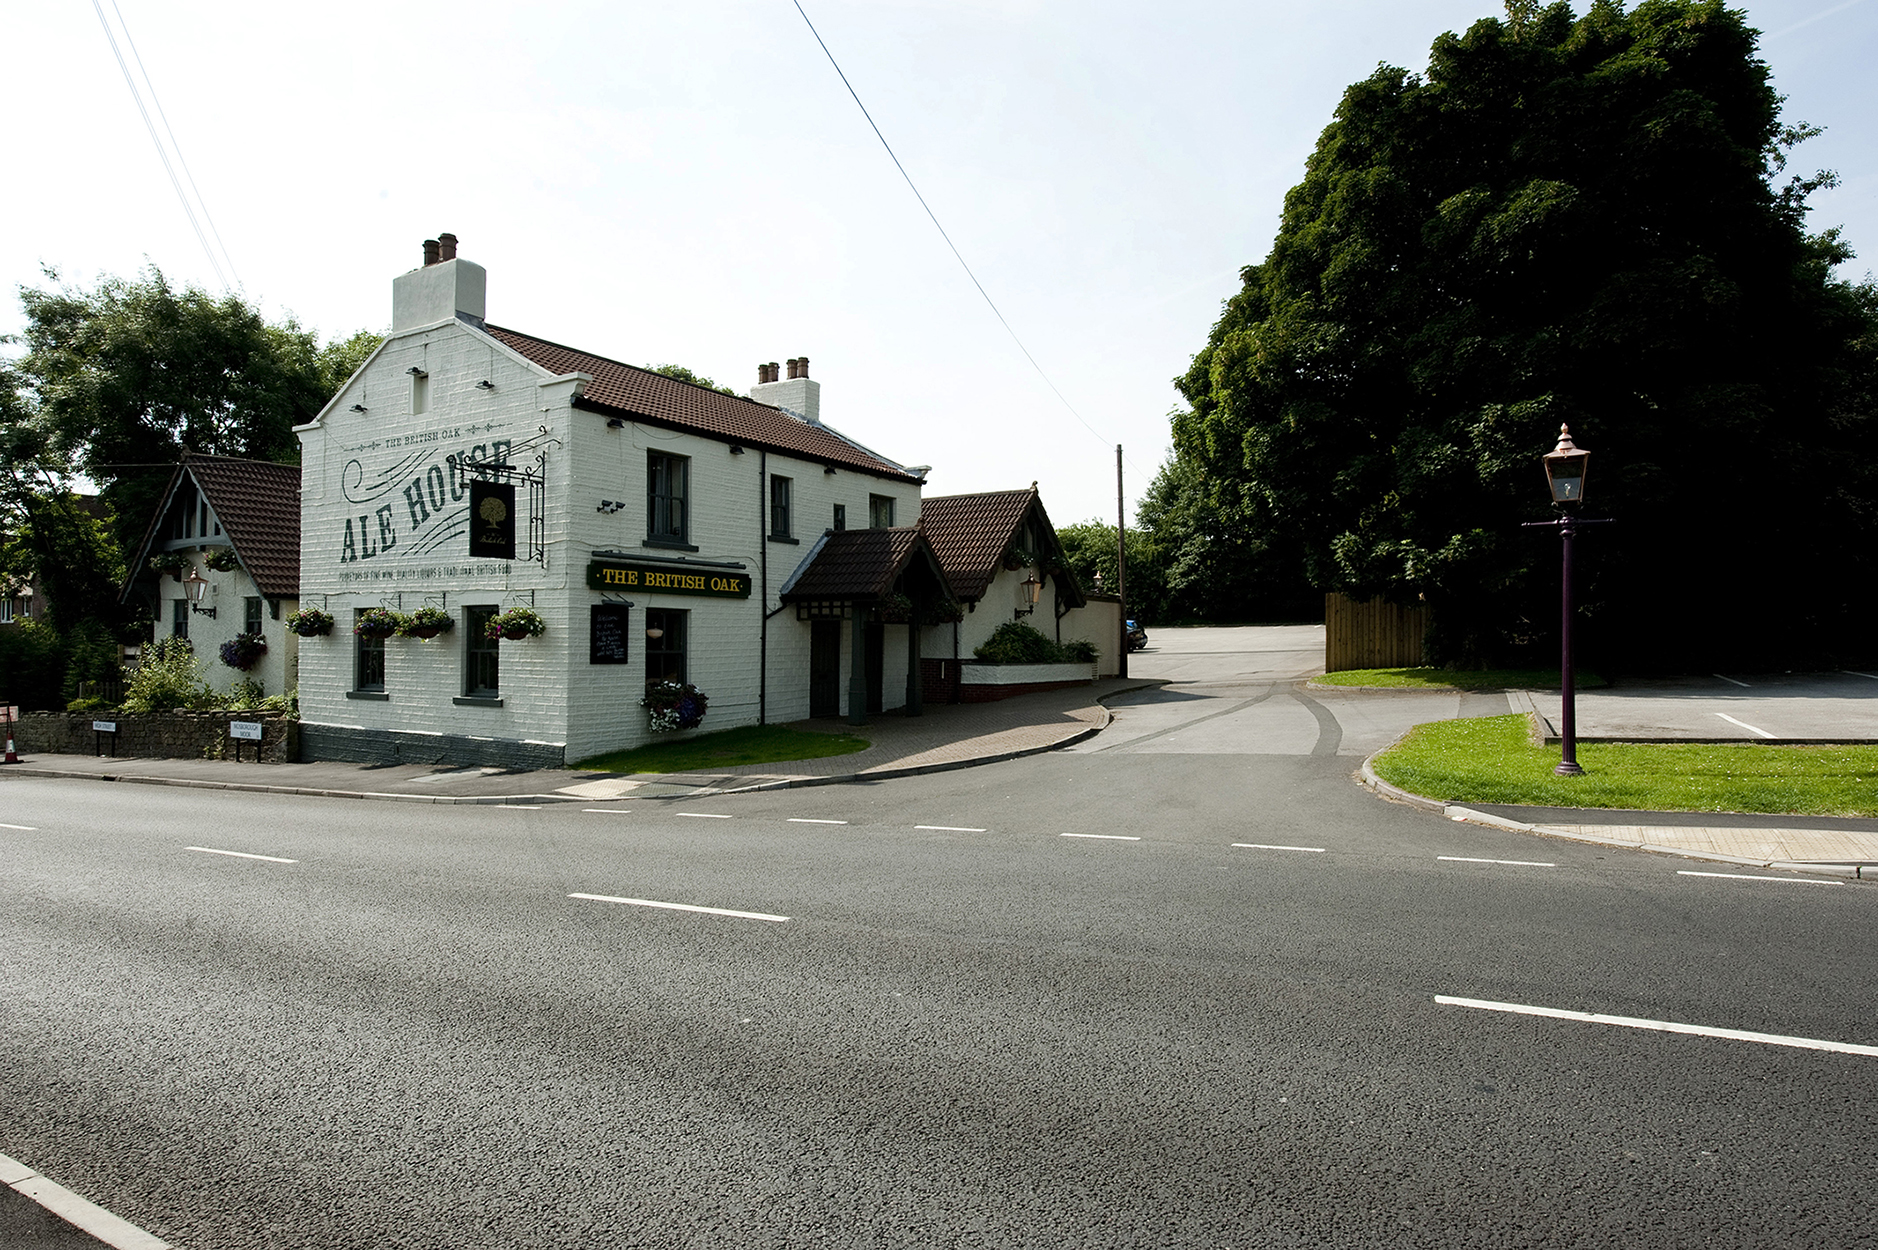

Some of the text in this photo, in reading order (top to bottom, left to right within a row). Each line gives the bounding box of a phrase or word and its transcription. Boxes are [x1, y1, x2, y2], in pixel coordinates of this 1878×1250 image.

[385, 426, 460, 449] THE BRITISH OAK
[340, 439, 512, 563] ALE HOUSE
[602, 568, 740, 592] THE BRITISH OAK
